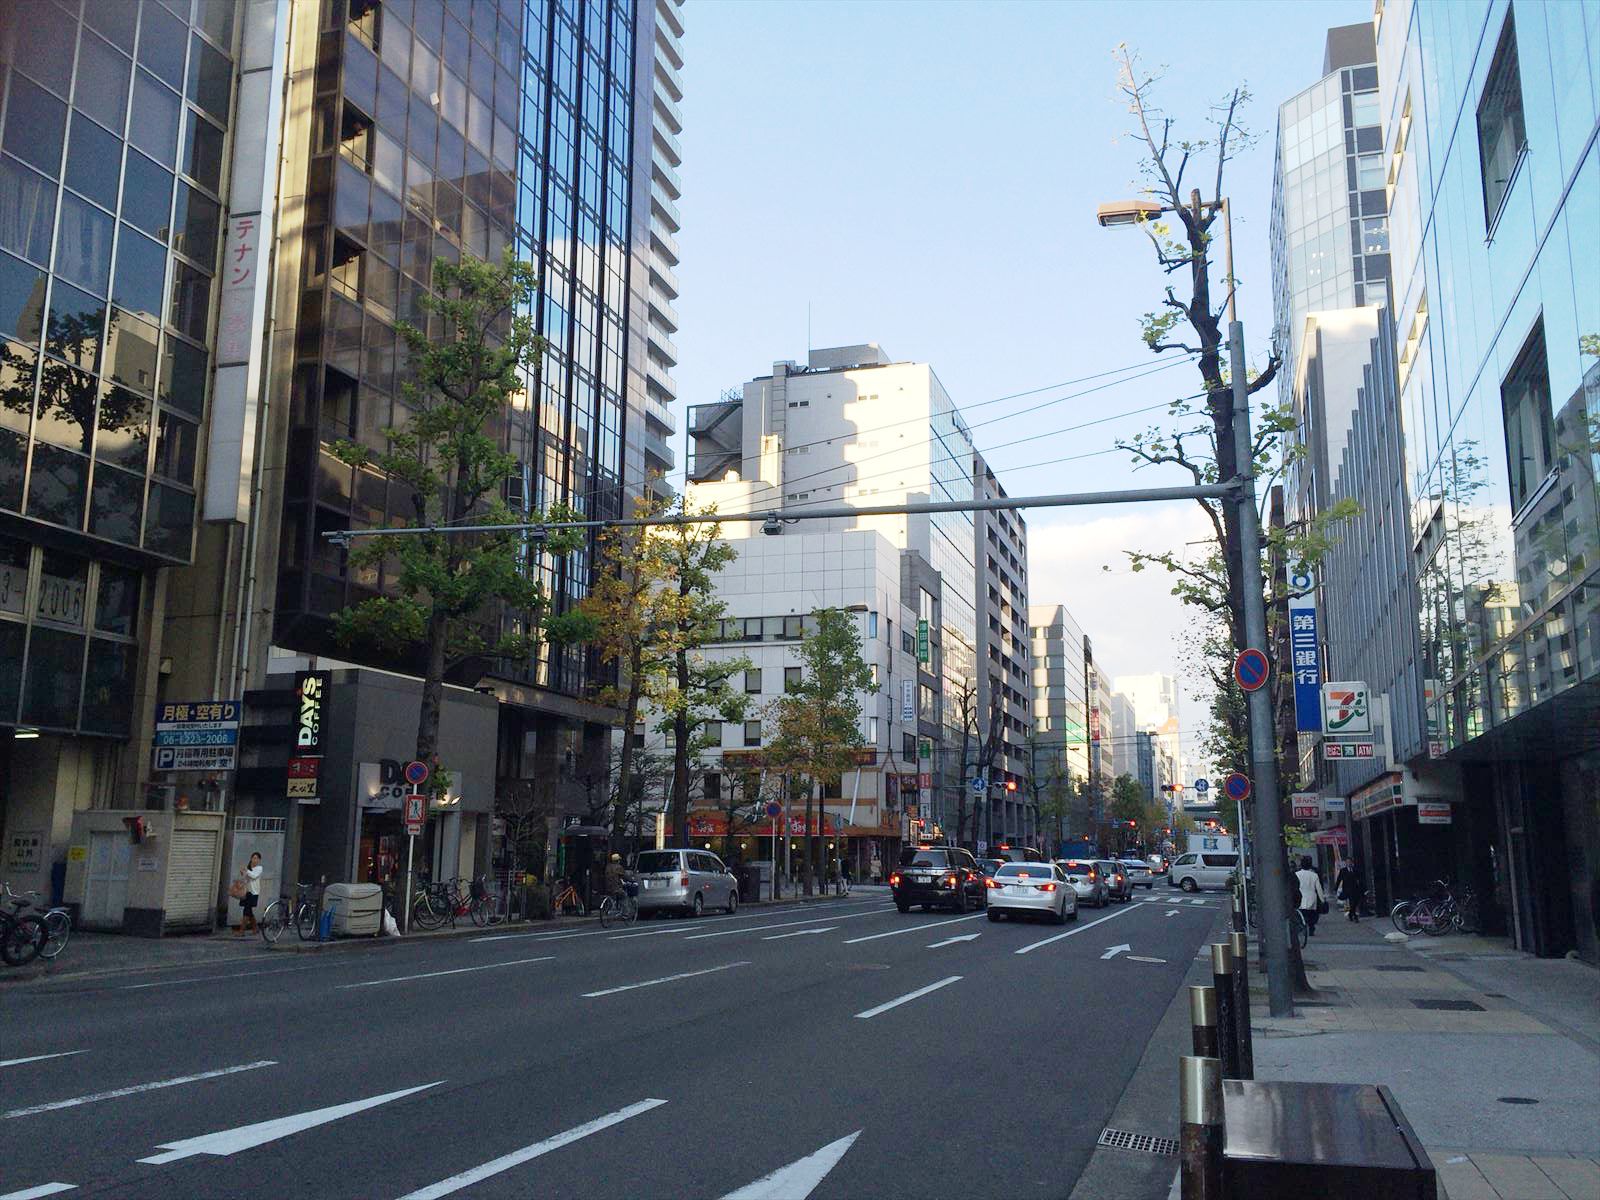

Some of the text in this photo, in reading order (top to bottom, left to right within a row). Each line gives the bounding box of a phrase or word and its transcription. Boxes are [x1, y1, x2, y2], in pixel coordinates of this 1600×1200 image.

[39, 580, 83, 620] 2006
[1293, 615, 1318, 685] 第三銀行
[298, 677, 317, 746] DAYS
[311, 678, 323, 746] COFFEE
[160, 749, 174, 768] P
[1358, 745, 1372, 756] ATM
